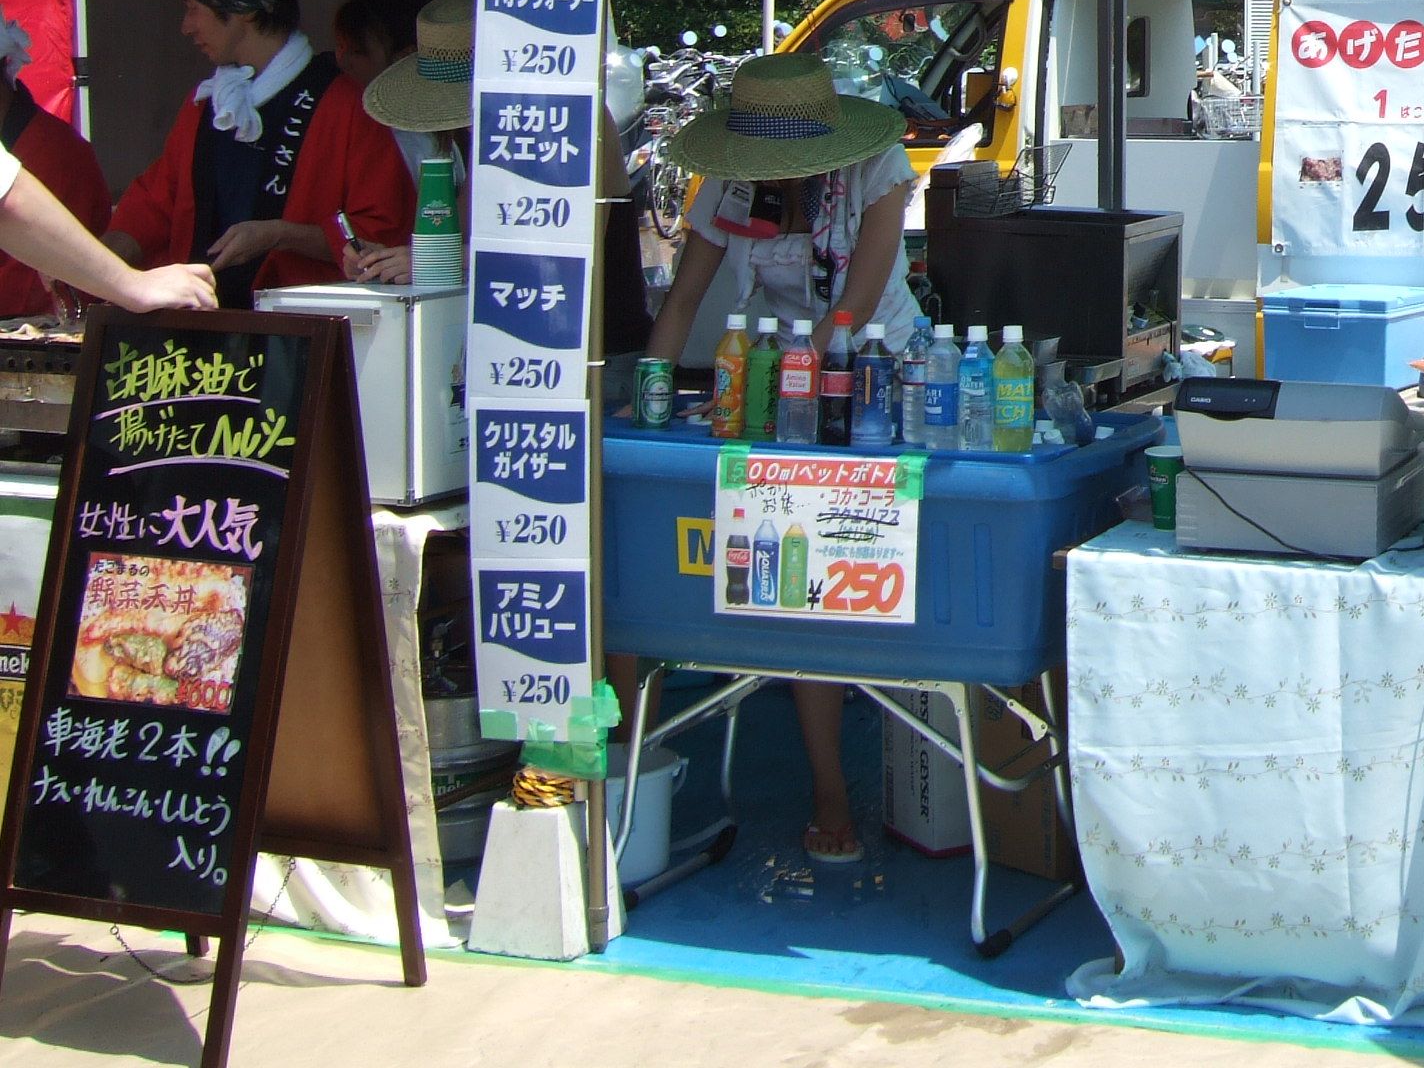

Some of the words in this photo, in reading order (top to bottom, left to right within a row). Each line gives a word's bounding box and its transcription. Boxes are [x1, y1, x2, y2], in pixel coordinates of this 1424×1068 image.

[501, 42, 576, 76] ¥250
[497, 105, 569, 133] ポカリ
[489, 135, 580, 164] スエット
[496, 197, 571, 229] ¥250
[489, 280, 566, 313] マッチ
[104, 339, 265, 402] 胡麻油で
[489, 356, 562, 390] ¥250
[484, 419, 577, 452] クリスタル
[493, 451, 567, 481] ガイザー
[78, 494, 263, 561] 女性に大人気
[495, 513, 567, 546] ¥250
[89, 576, 198, 616] 野菜天丼
[495, 581, 566, 611] アミノ
[488, 611, 576, 642] バリュー
[500, 673, 571, 706] ¥250
